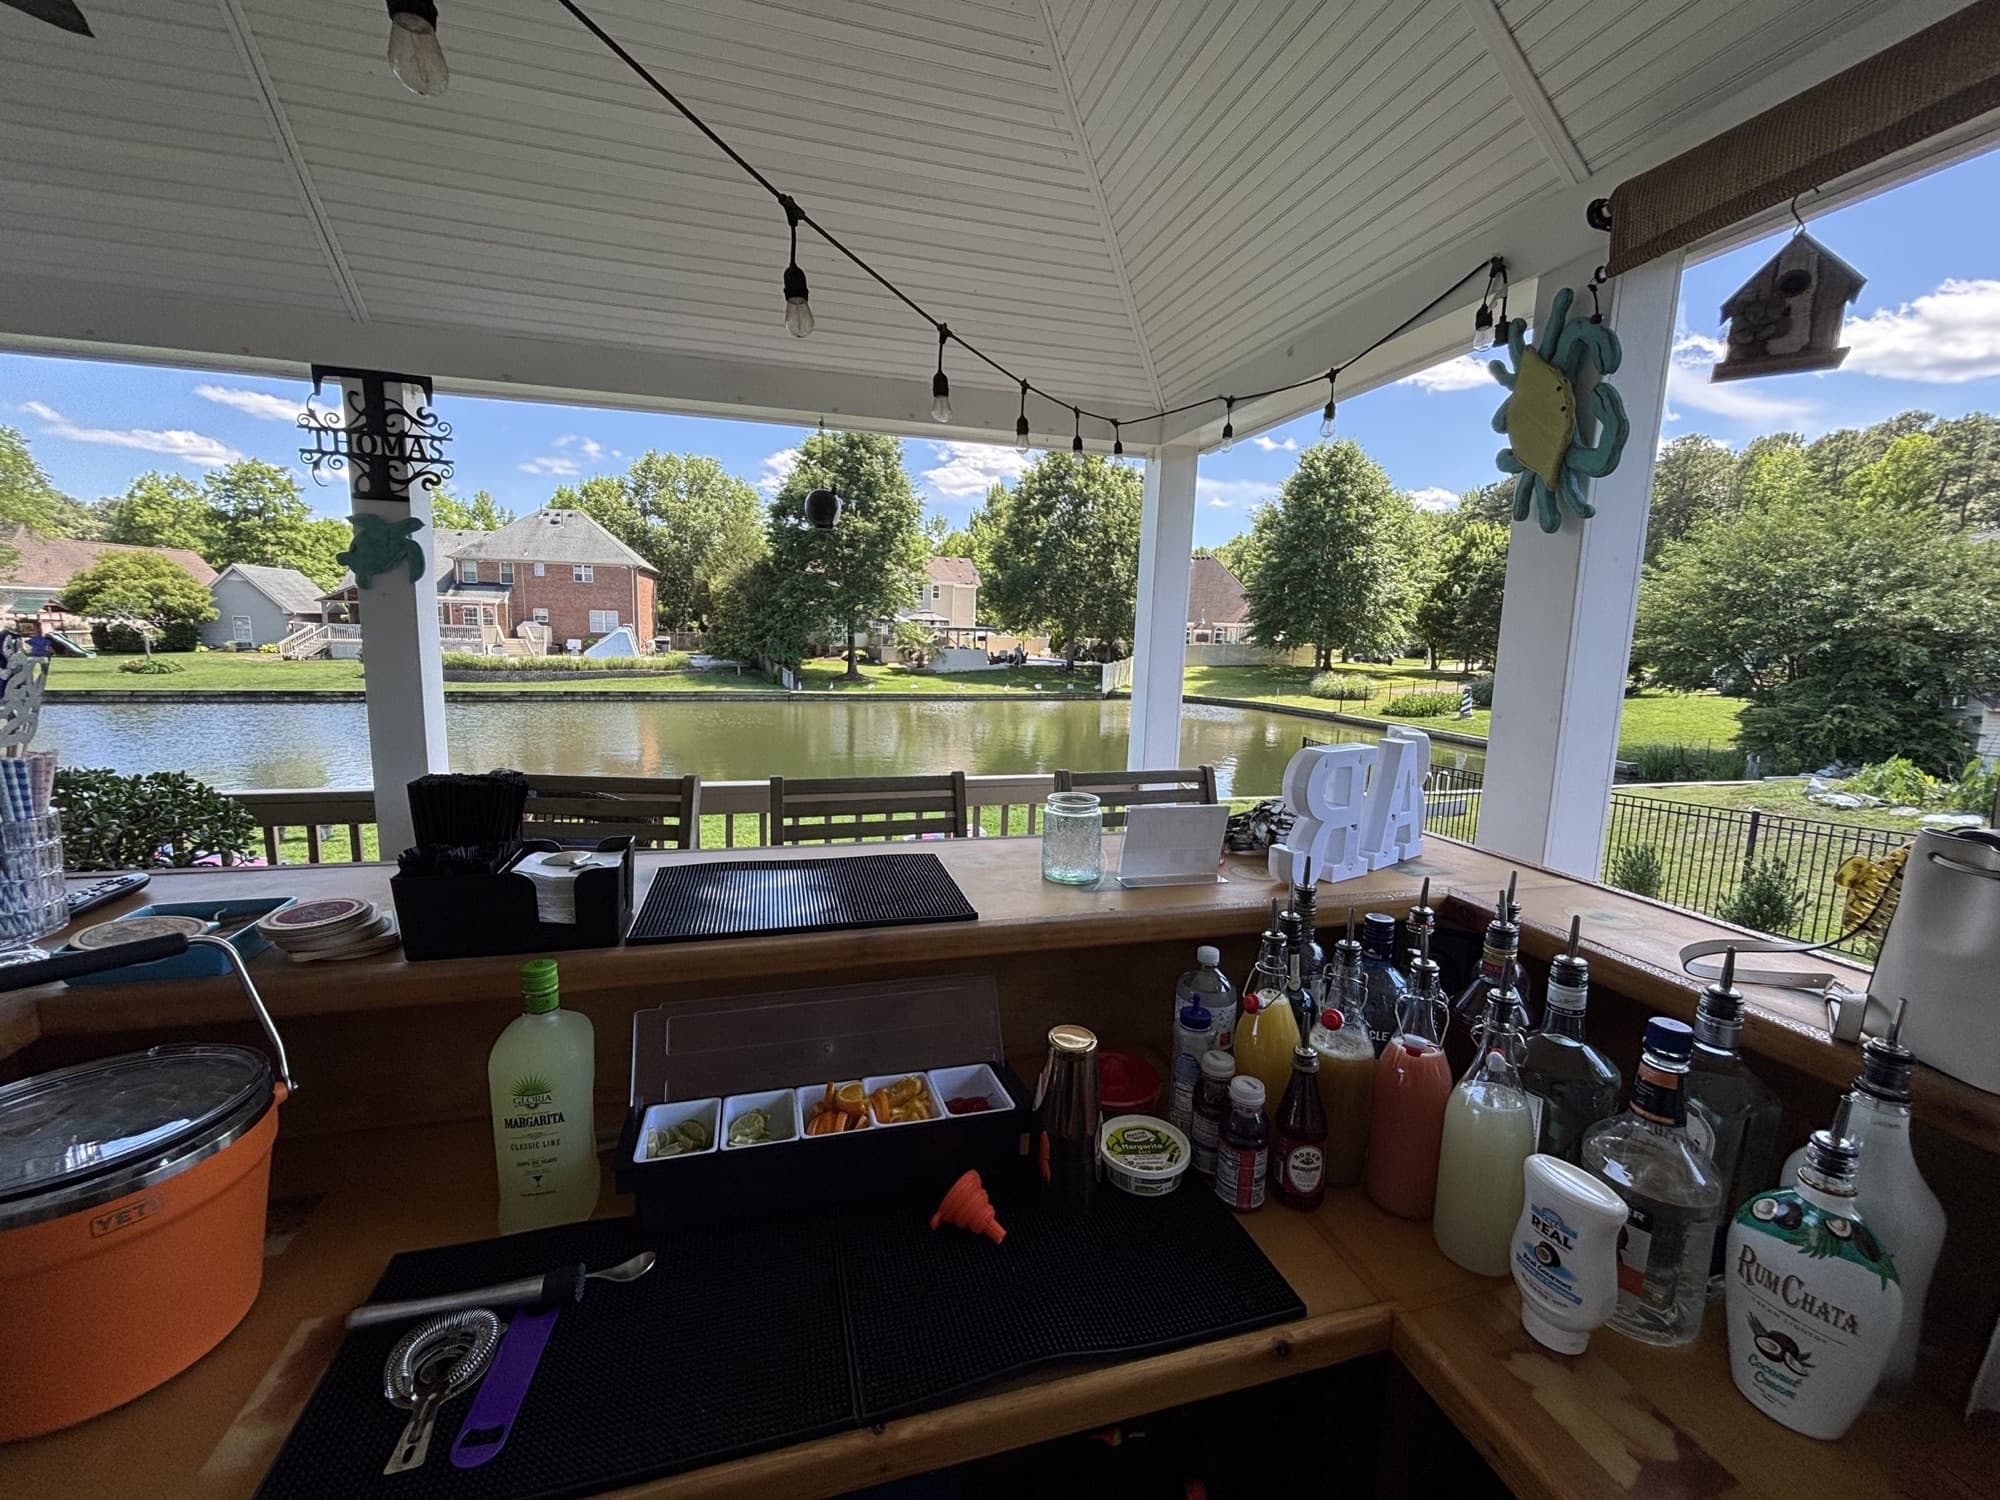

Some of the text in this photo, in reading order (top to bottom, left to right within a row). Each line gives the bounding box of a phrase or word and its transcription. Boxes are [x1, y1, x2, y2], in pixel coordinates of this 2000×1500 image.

[309, 428, 446, 462] THOMAS
[512, 1094, 552, 1108] GLORIA
[504, 1112, 565, 1129] MARGARITA
[510, 1139, 561, 1151] CLASSIC LIME
[1531, 1214, 1573, 1250] REAL
